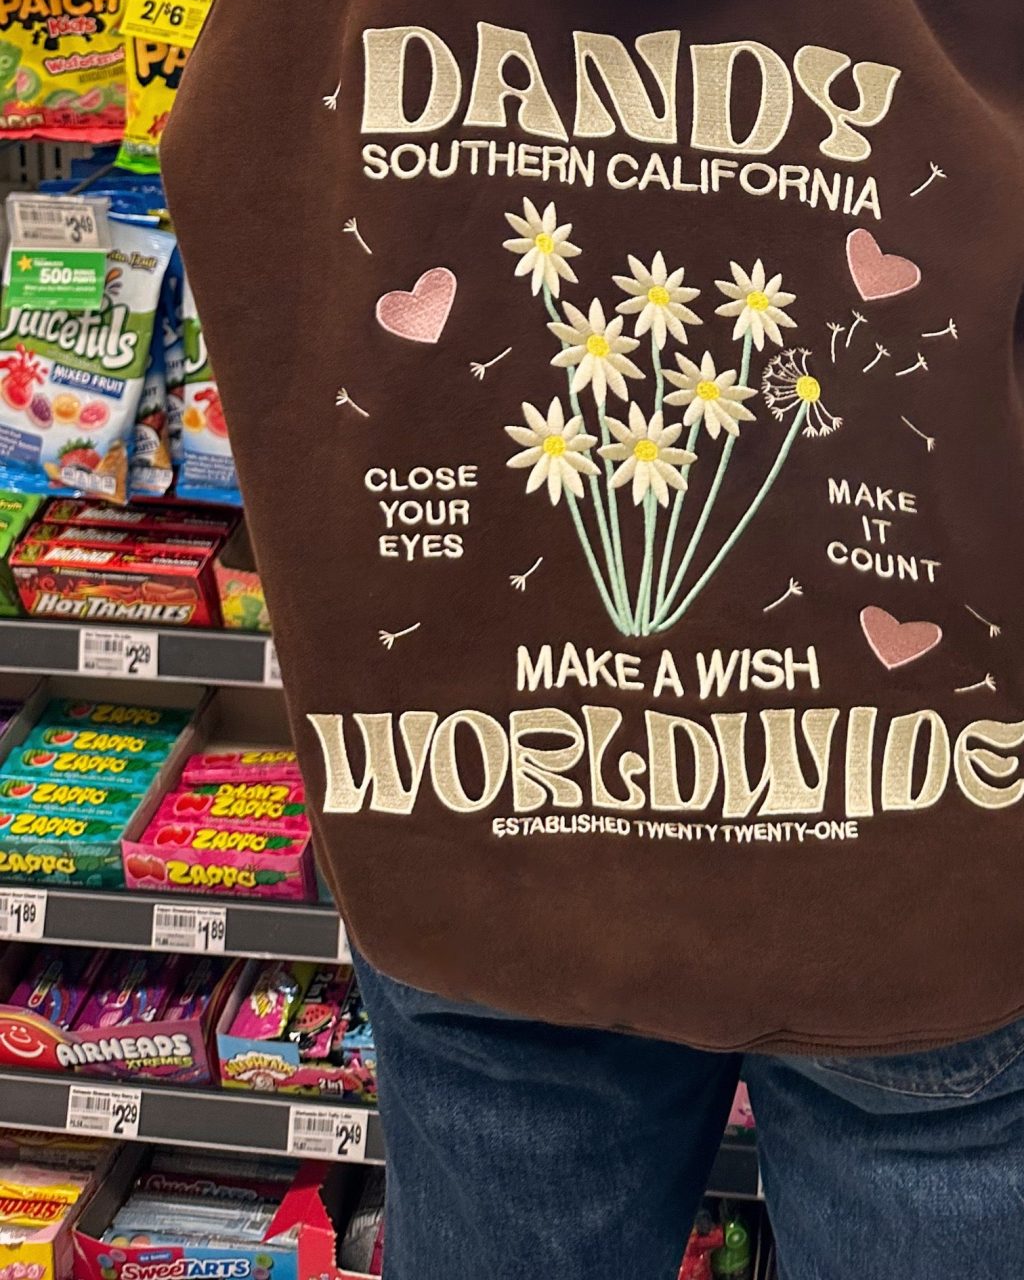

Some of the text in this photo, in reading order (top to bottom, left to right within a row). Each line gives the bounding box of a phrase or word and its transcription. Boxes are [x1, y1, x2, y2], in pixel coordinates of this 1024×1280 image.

[141, 0, 185, 26] 2/$6
[361, 21, 901, 162] DANDY
[361, 139, 882, 220] SOUTHERN CALIFORNIA
[40, 267, 72, 284] 500
[54, 363, 126, 395] MIXED FRUIT
[364, 465, 478, 492] CLOSE
[828, 477, 918, 513] MAKE
[379, 499, 470, 528] YOUR
[862, 515, 892, 544] IT
[379, 533, 464, 561] EYES
[827, 541, 941, 583] COUNT
[36, 592, 193, 621] HOT TAMALES
[516, 642, 820, 700] MAKE A WISH
[73, 731, 146, 753] ZAPPO
[53, 751, 128, 774] ZAPPO
[31, 782, 109, 806] ZAPPO
[210, 796, 285, 820] ZAPPO
[10, 813, 88, 837] ZAPPO
[492, 814, 859, 844] ESTABLISHED TWENTY TWENTY-ONE
[192, 828, 268, 853] ZAPPO
[166, 860, 257, 889] ZAPPO
[56, 1033, 192, 1068] AIRHEADS
[125, 1055, 193, 1070] XTREMES
[121, 1257, 251, 1280] SweeTARTS
